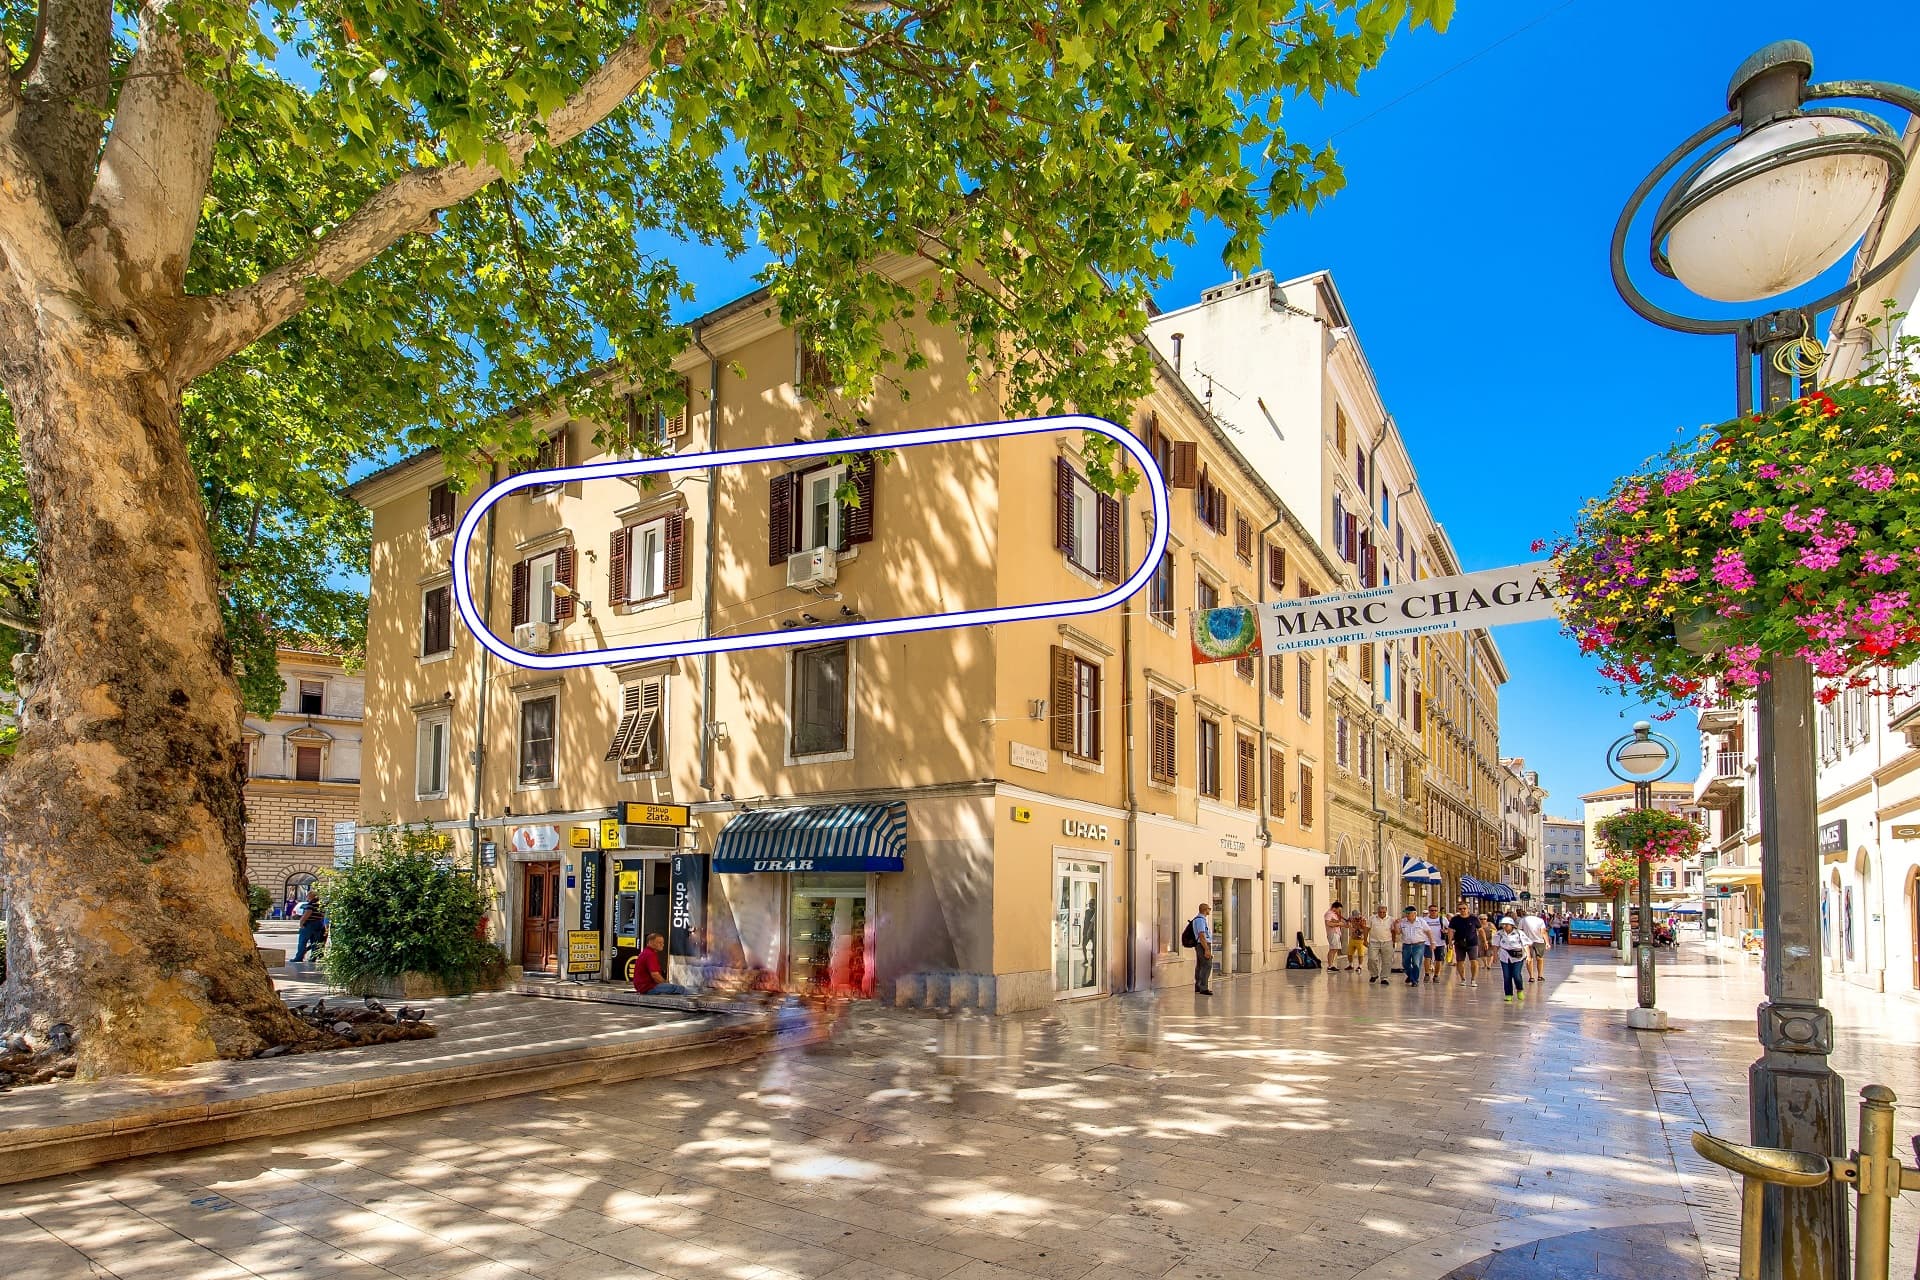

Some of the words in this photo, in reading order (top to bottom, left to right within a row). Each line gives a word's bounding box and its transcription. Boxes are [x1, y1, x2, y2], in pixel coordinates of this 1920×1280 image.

[1272, 600, 1302, 610] izložba
[1309, 595, 1340, 606] mostra
[1347, 588, 1394, 600] exhibition
[1274, 601, 1389, 637] MARC
[1400, 576, 1574, 619] CHAGA
[1276, 637, 1326, 651] GALERIJA
[1328, 631, 1368, 645] KORTIL
[1375, 623, 1449, 638] Strossmayerova
[647, 805, 669, 814] Otkup
[1064, 818, 1109, 841] URAR
[753, 859, 814, 871] URAR
[673, 882, 686, 928] Otkup
